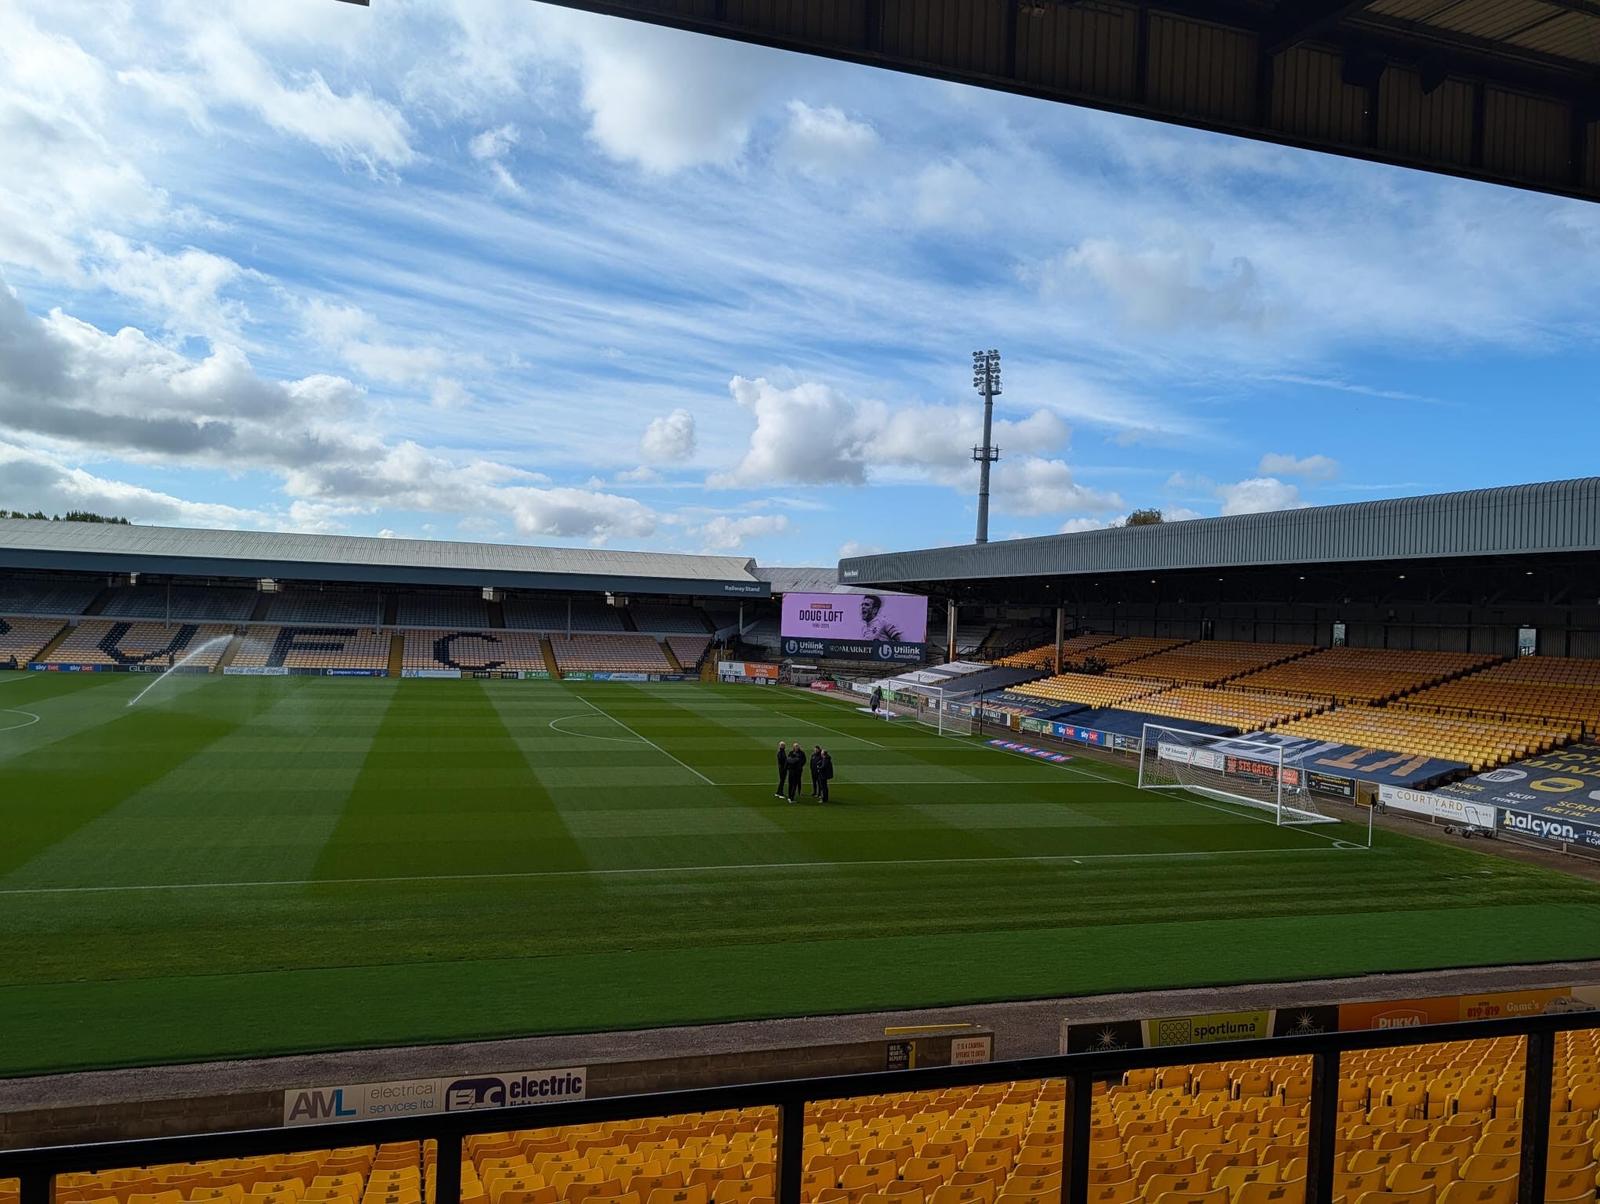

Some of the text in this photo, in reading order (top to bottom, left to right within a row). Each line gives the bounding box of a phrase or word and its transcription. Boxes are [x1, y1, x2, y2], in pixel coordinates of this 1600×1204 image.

[799, 609, 844, 622] DOUG LOFT
[799, 641, 824, 650] Utilink
[894, 646, 920, 655] Utilink
[69, 664, 81, 672] sky
[1252, 763, 1274, 777] GATES
[1396, 790, 1464, 812] COURTYARD
[1506, 791, 1537, 801] SKIP
[1194, 1020, 1256, 1039] sportluma
[370, 1081, 436, 1100] electrical
[510, 1072, 582, 1098] electric
[289, 1088, 356, 1121] AML
[369, 1097, 434, 1114] services ltd
